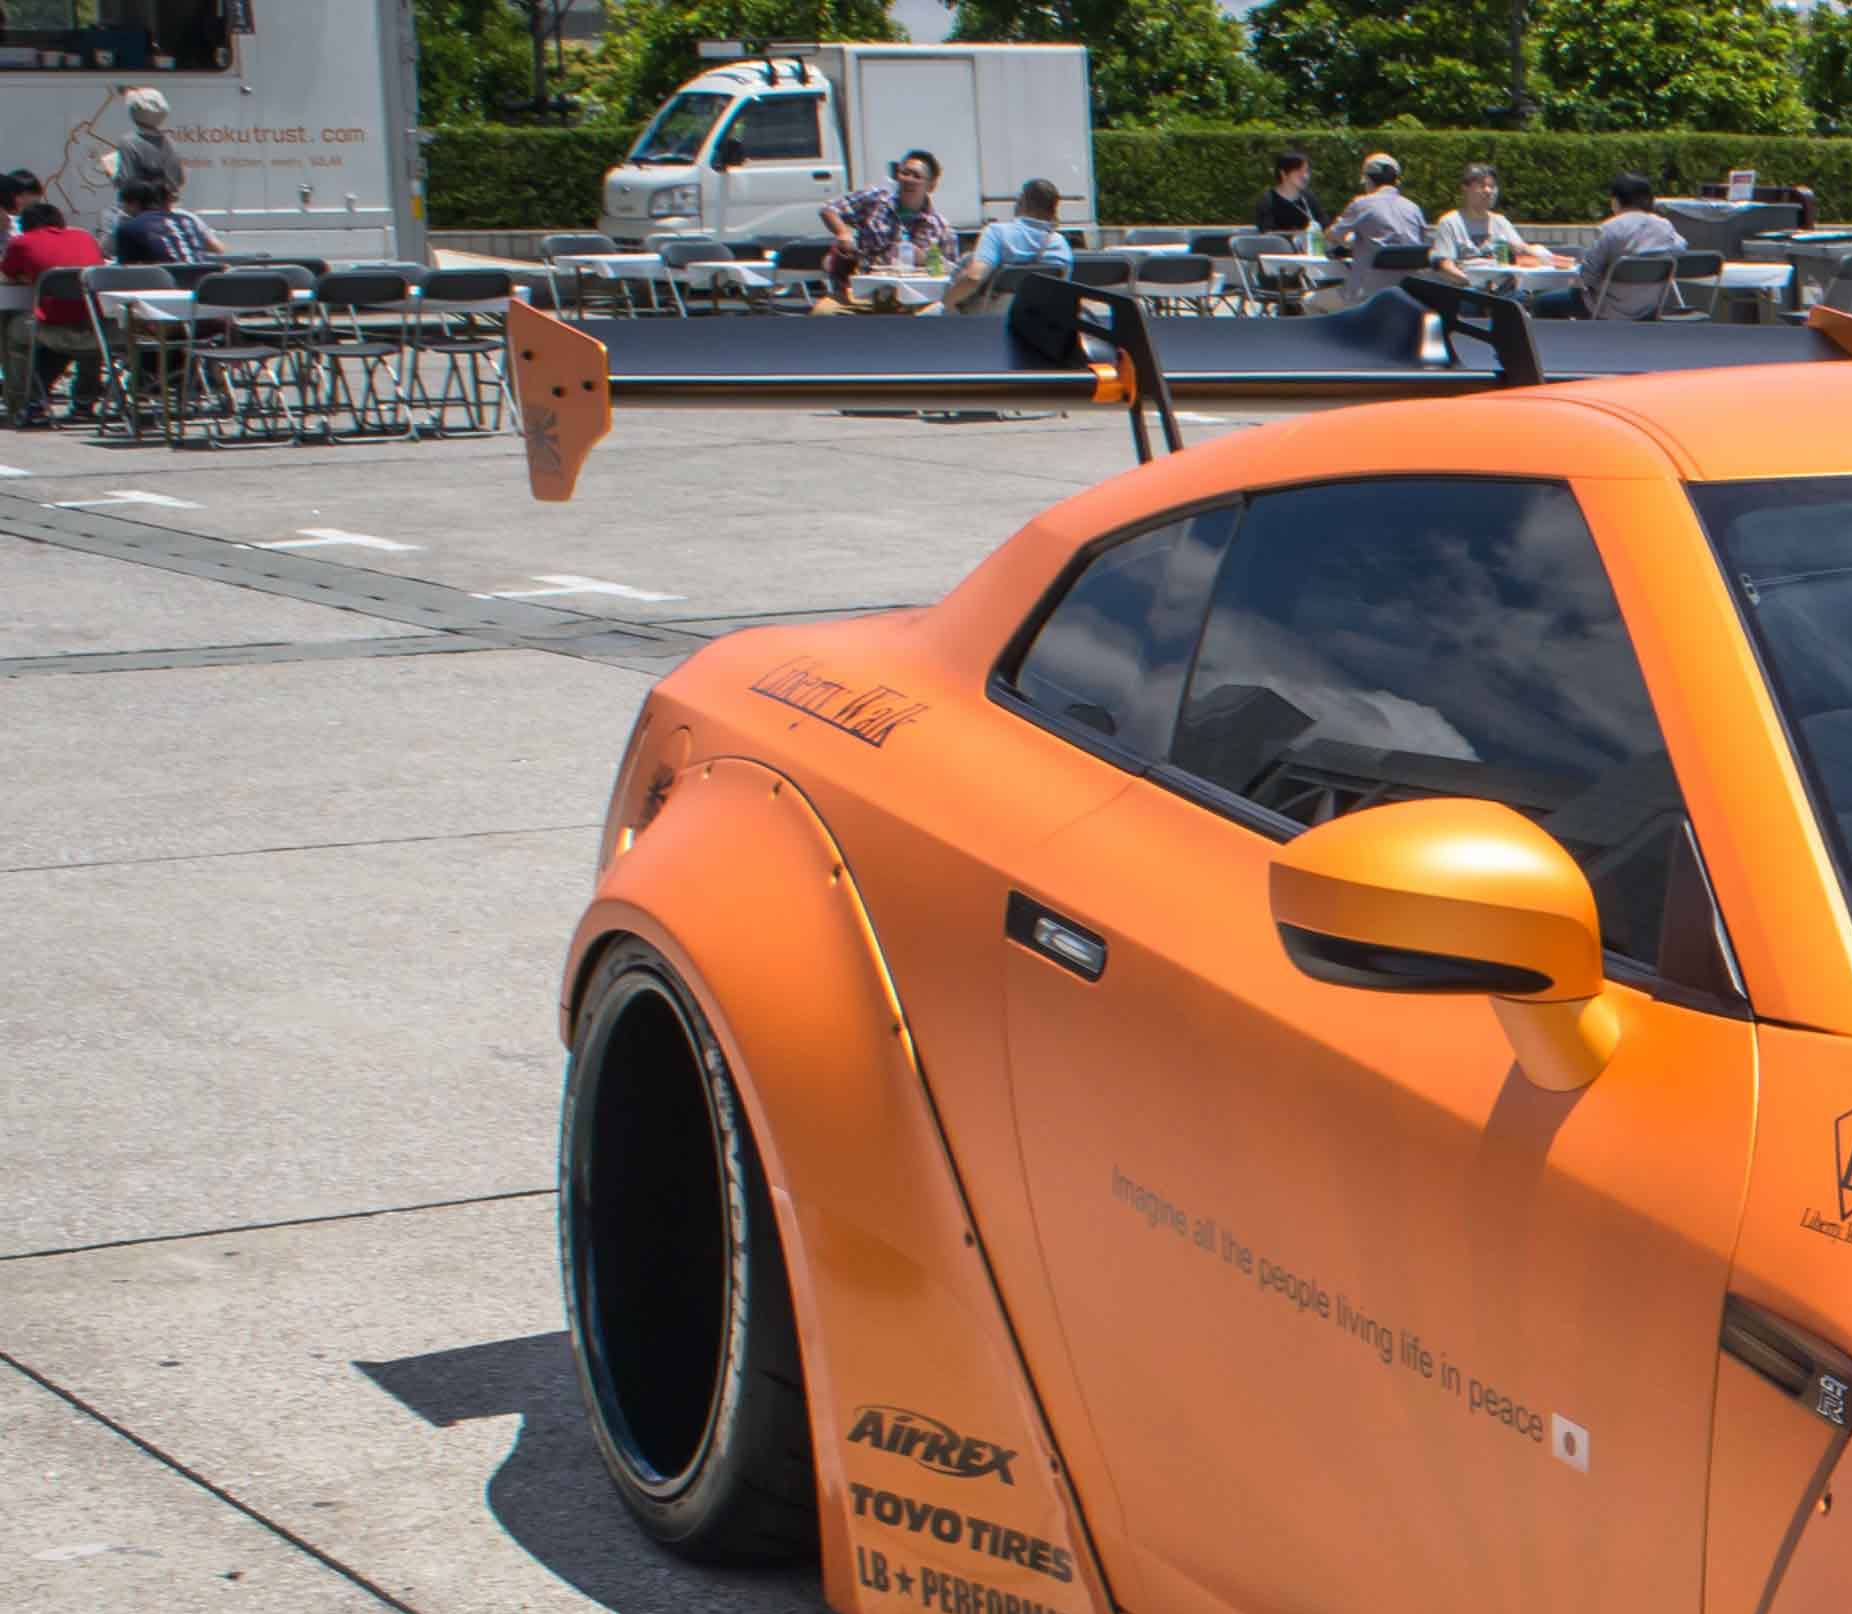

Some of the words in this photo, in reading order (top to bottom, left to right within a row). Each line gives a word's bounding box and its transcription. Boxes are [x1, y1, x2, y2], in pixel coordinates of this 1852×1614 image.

[1111, 1164, 1188, 1238] Imagine
[1192, 1216, 1217, 1252] all
[1220, 1229, 1254, 1275] the
[1258, 1255, 1331, 1319] people
[1335, 1295, 1395, 1364] living
[1400, 1328, 1434, 1380] life
[1440, 1352, 1463, 1396] in
[1468, 1377, 1545, 1444] peace
[850, 1482, 963, 1545] TOYO
[967, 1516, 1074, 1584] TIRES
[856, 1545, 891, 1592] LB
